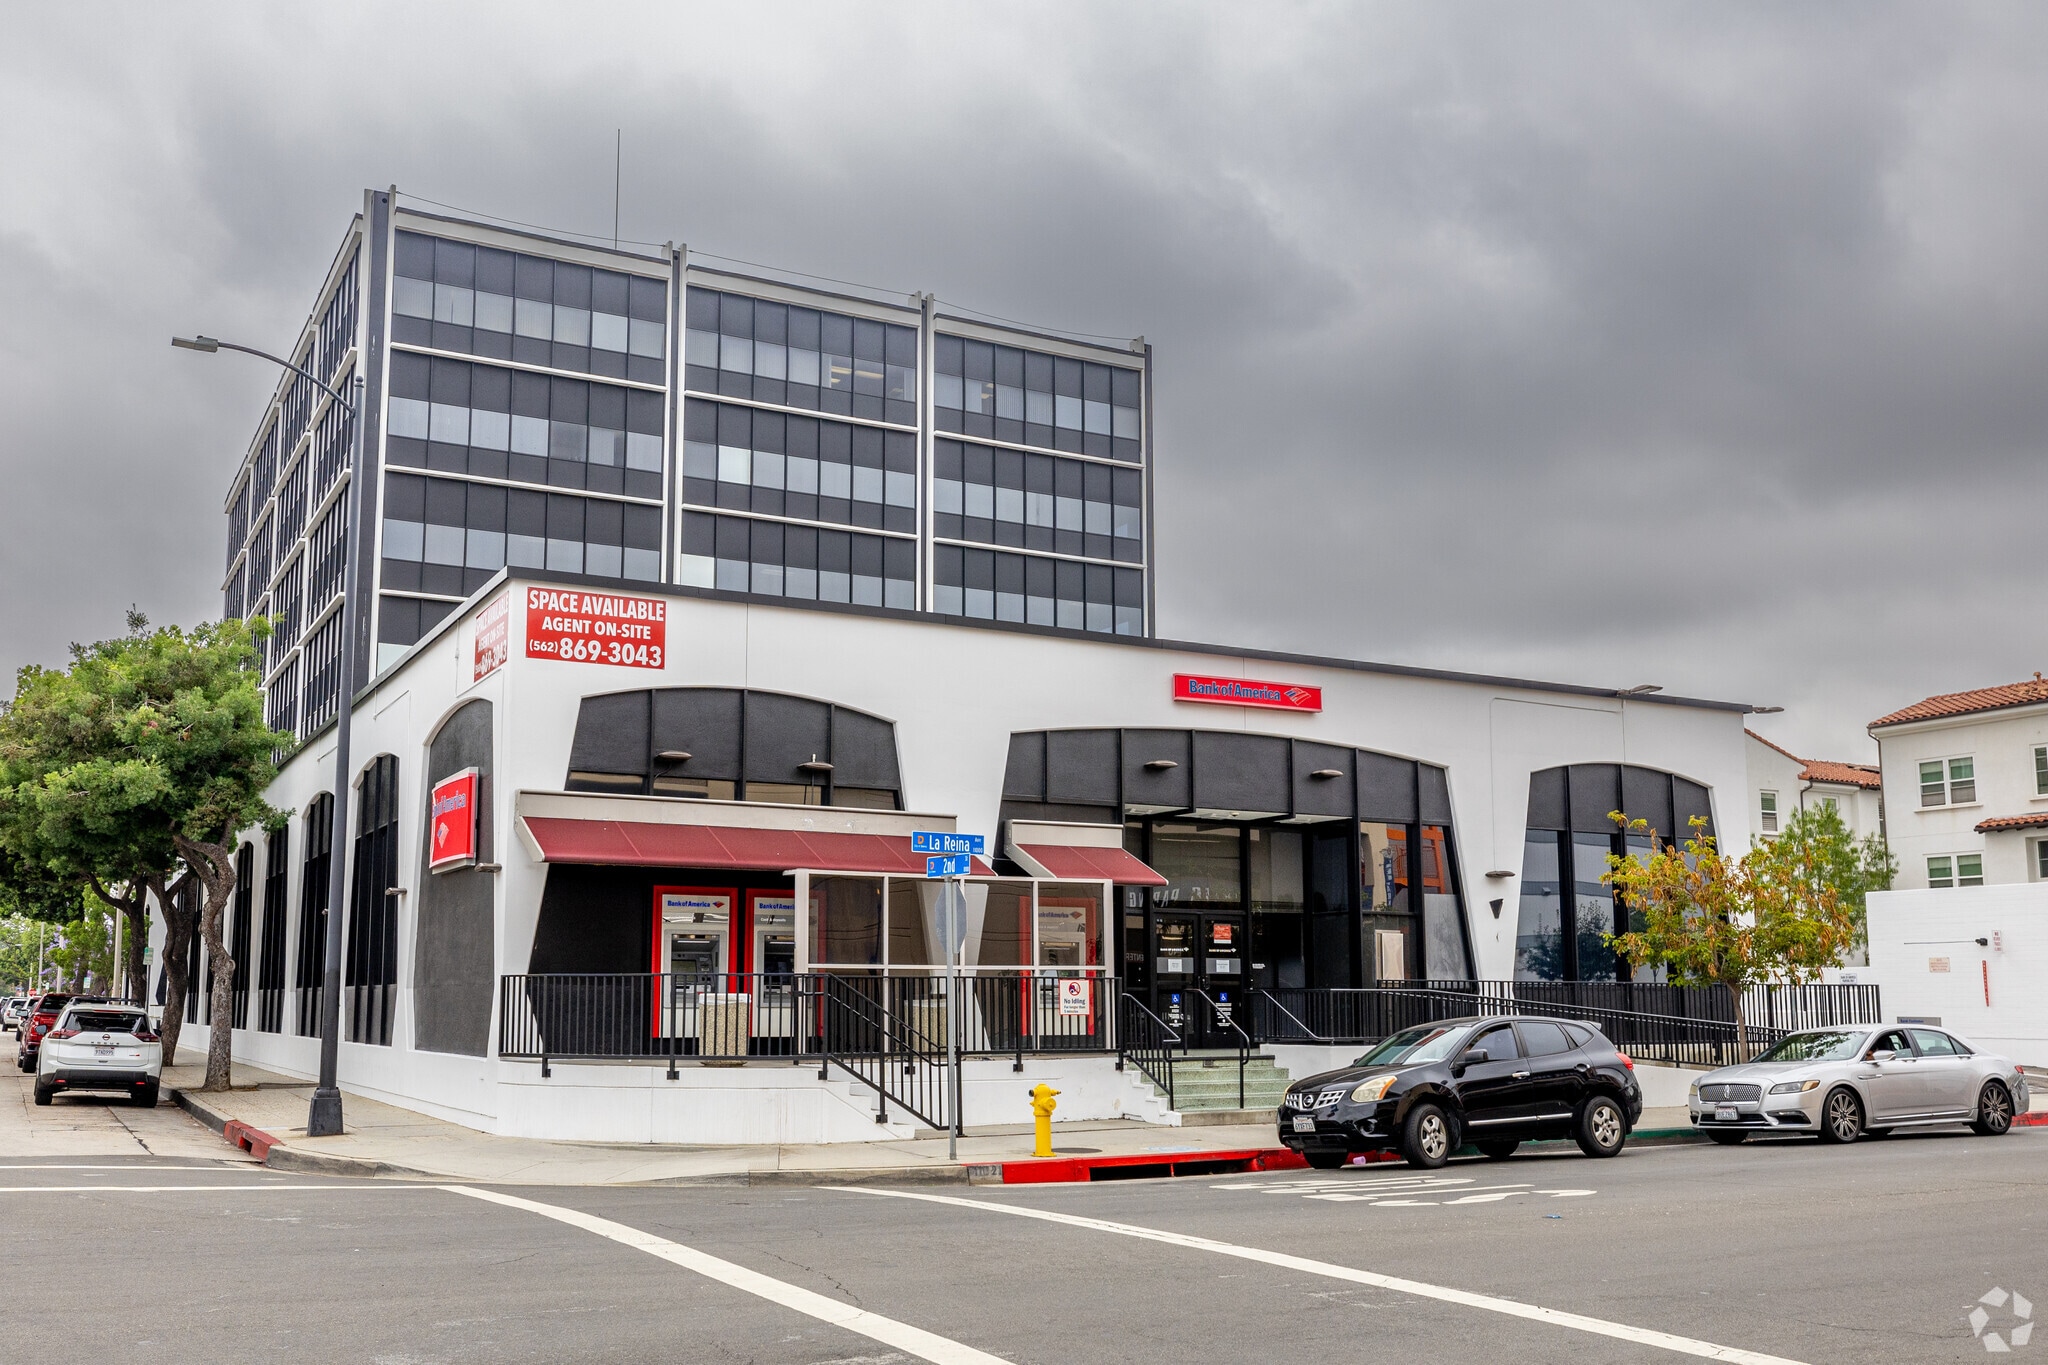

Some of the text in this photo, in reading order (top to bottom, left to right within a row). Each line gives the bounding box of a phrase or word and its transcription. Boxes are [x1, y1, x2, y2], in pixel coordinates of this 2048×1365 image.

[529, 590, 664, 622] SPACE AVAILABLE
[542, 617, 651, 640] AGENT ON-SITE
[529, 637, 661, 667] (562) 869-3043
[1189, 679, 1281, 701] Bank of America
[929, 834, 940, 851] La
[944, 835, 970, 852] Reina
[943, 857, 956, 874] 2nd
